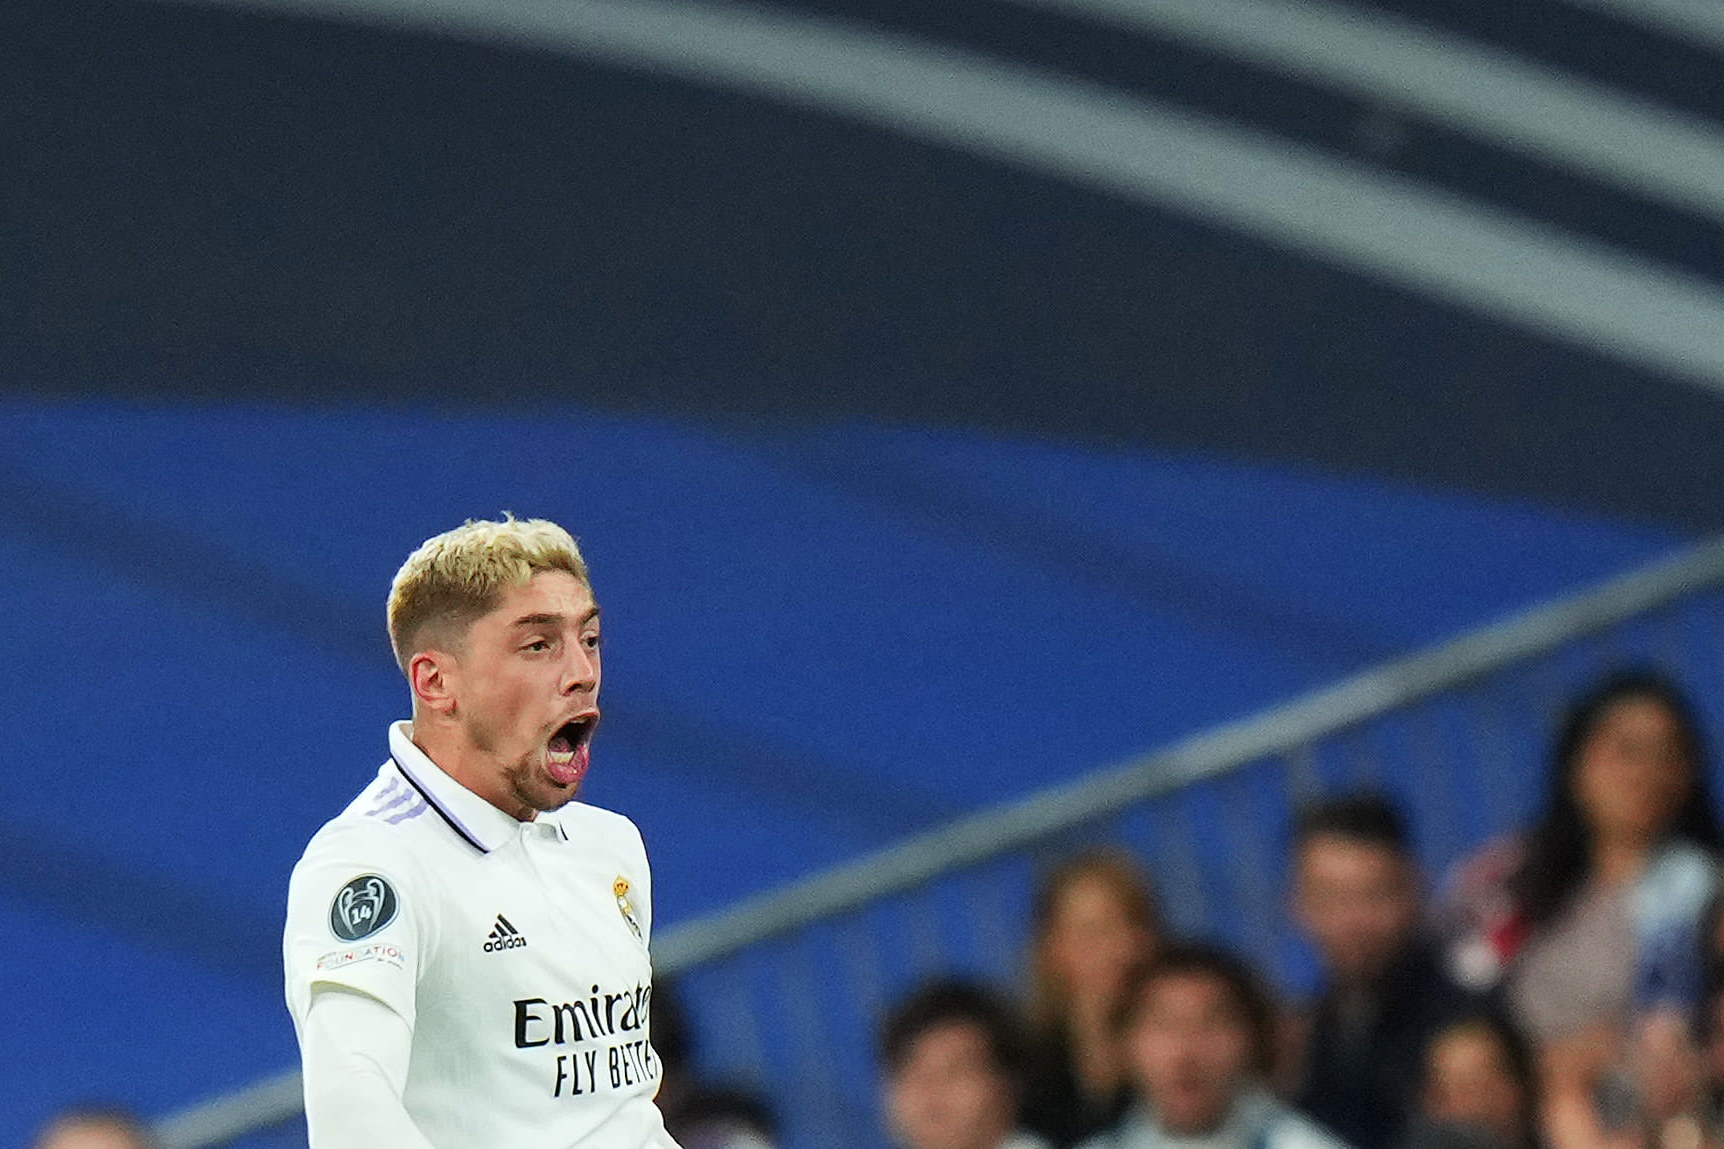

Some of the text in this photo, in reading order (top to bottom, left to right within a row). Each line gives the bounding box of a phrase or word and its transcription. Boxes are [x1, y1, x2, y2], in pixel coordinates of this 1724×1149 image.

[352, 905, 372, 924] 14
[483, 934, 527, 952] adidas
[554, 1040, 658, 1097] FLY BETTE
